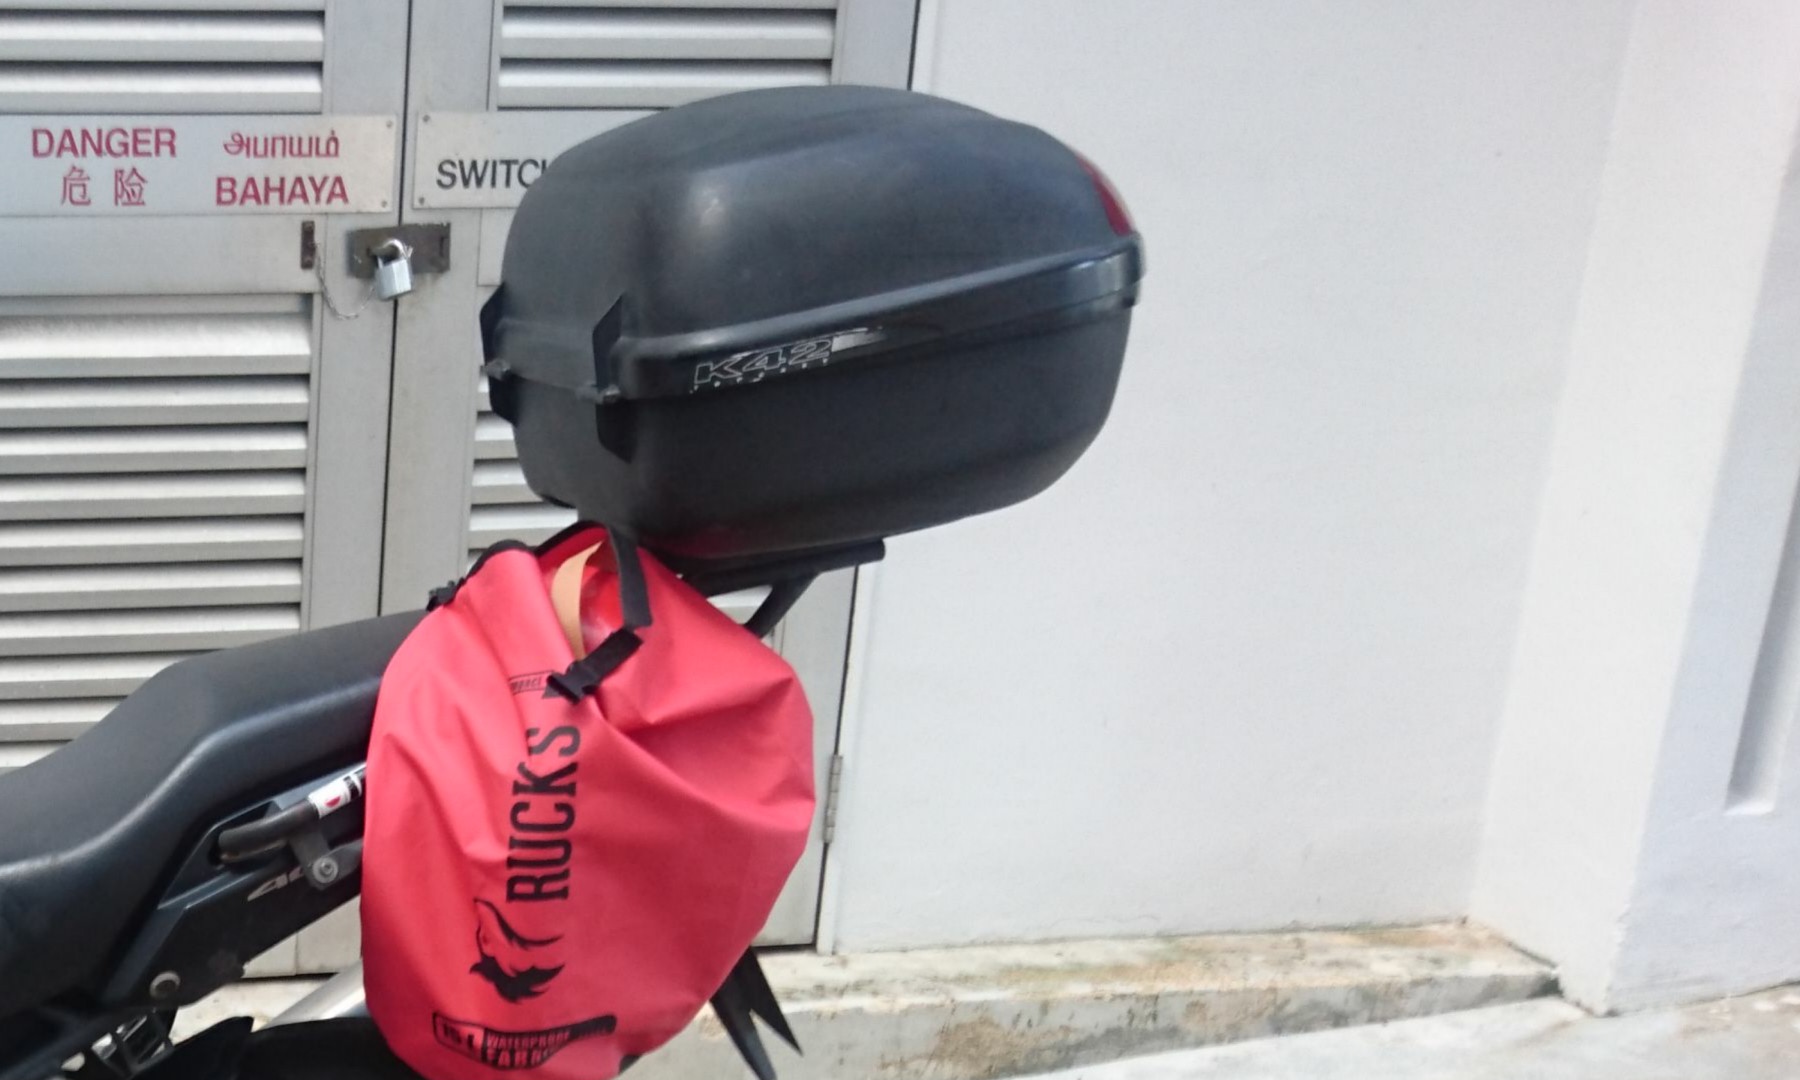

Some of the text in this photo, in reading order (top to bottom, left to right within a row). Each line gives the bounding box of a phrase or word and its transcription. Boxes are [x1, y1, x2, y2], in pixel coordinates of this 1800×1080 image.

[31, 127, 178, 159] DANGER
[222, 129, 341, 159] அபாயம்
[60, 165, 147, 206] 危险
[436, 158, 548, 190] SWITC
[214, 175, 350, 207] BAHAYA
[693, 338, 833, 385] K42
[505, 724, 581, 904] RUCKS
